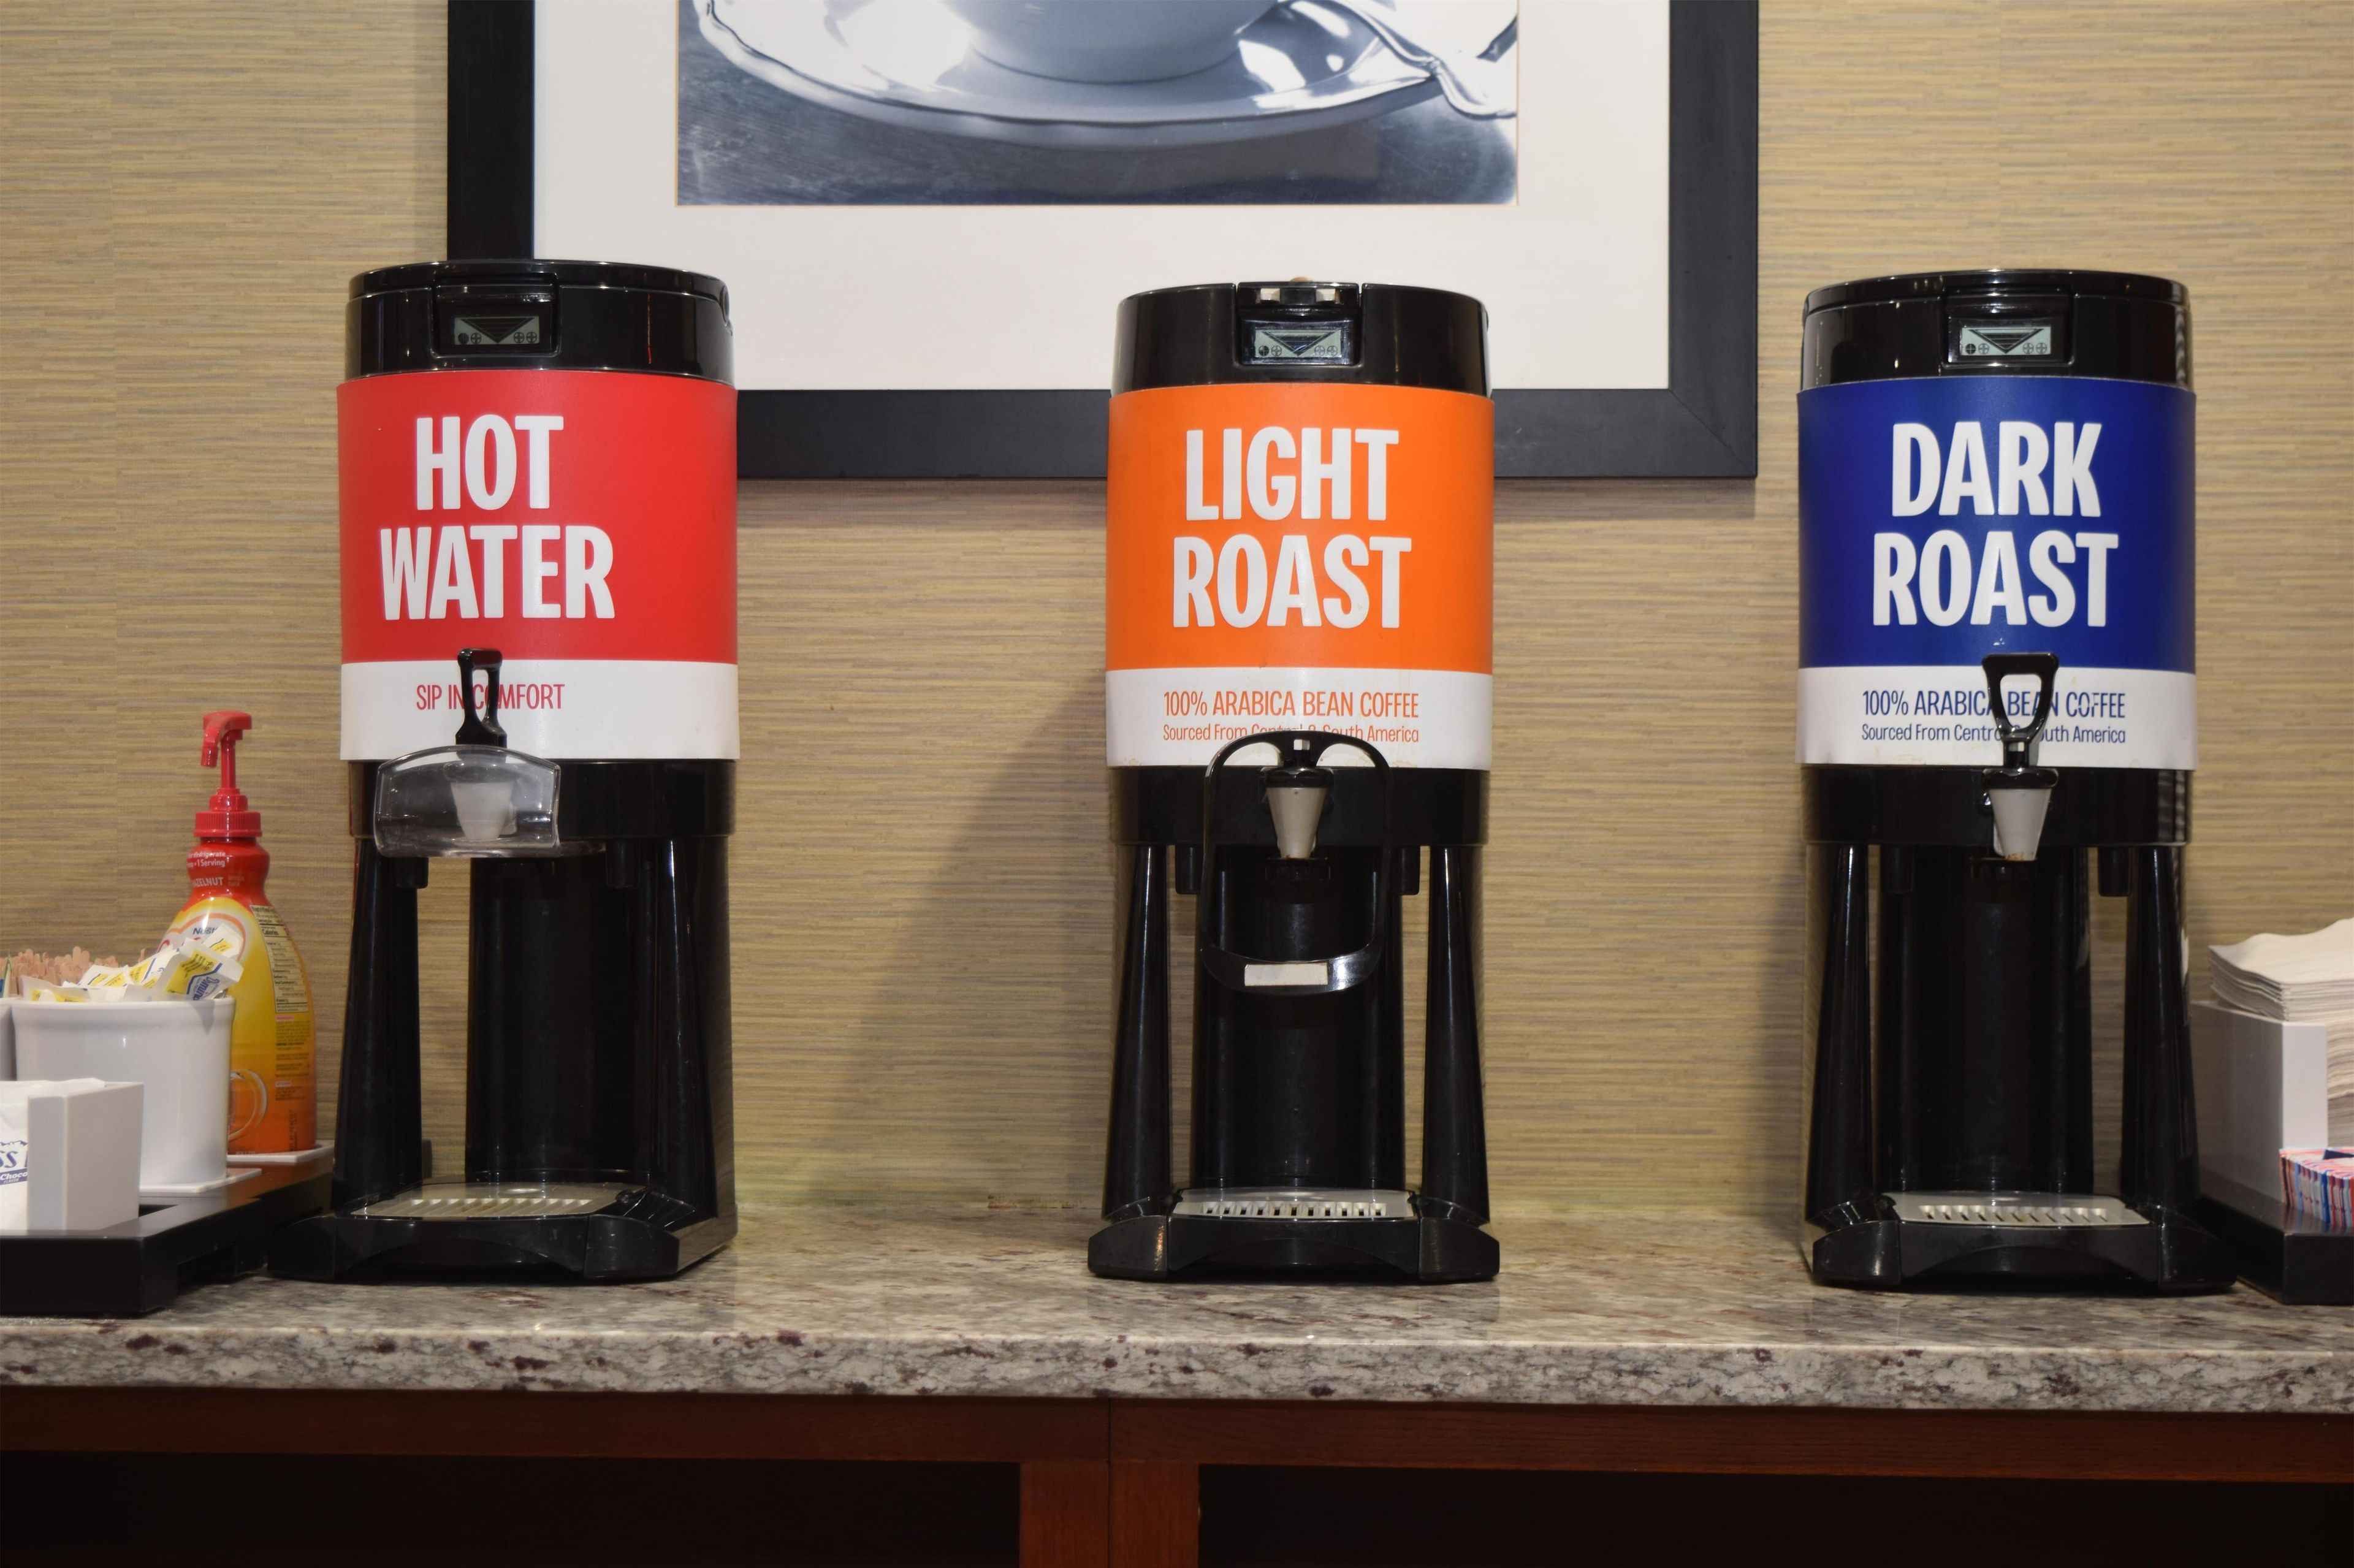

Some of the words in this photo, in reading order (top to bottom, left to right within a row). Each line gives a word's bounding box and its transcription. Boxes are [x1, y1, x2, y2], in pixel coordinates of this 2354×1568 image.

[417, 415, 564, 511] HOT
[1186, 426, 1400, 522] LIGHT
[1892, 421, 2103, 518] DARK
[381, 525, 615, 621] WATER
[1173, 534, 1412, 630] ROAST
[1873, 530, 2119, 628] ROAST
[416, 685, 443, 710] SIP
[1163, 723, 1211, 741] Sourced
[1214, 724, 1247, 740] From
[1366, 726, 1420, 743] America
[1164, 691, 1208, 717] 100%
[1213, 691, 1296, 717] ARABICA
[1303, 691, 1354, 717] BEAN
[1360, 691, 1420, 718] COFFEE
[1862, 690, 1908, 716] 100%
[2066, 692, 2126, 718] COFFEE
[1862, 725, 1912, 742] Sourced
[1916, 725, 1951, 741] From
[1954, 724, 2001, 741] Centr
[2073, 727, 2127, 744] America
